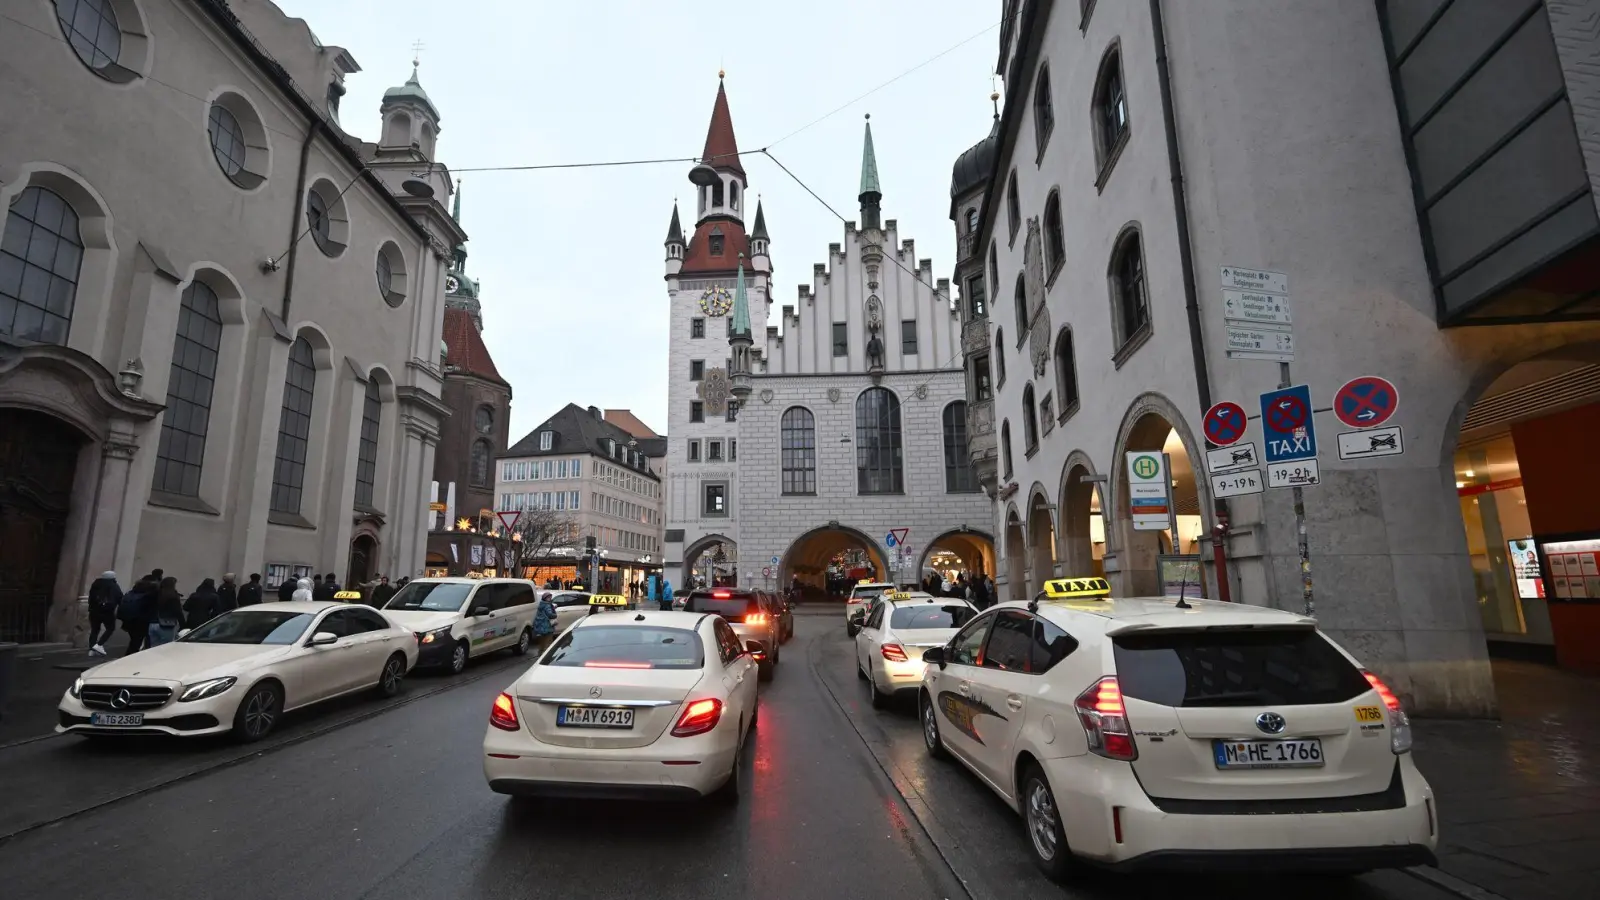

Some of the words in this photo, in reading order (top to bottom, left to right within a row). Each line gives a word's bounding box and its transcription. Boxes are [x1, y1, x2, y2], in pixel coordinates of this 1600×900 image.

[1269, 436, 1311, 455] TAXI
[1140, 460, 1152, 474] H
[1058, 579, 1101, 592] TAXI
[595, 596, 619, 604] TAXI
[566, 709, 574, 722] M
[582, 710, 599, 722] AY
[600, 711, 632, 724] 6919
[1356, 707, 1381, 720] 1766
[1226, 744, 1239, 762] M
[1248, 743, 1272, 761] HE
[1278, 741, 1321, 761] 1766
